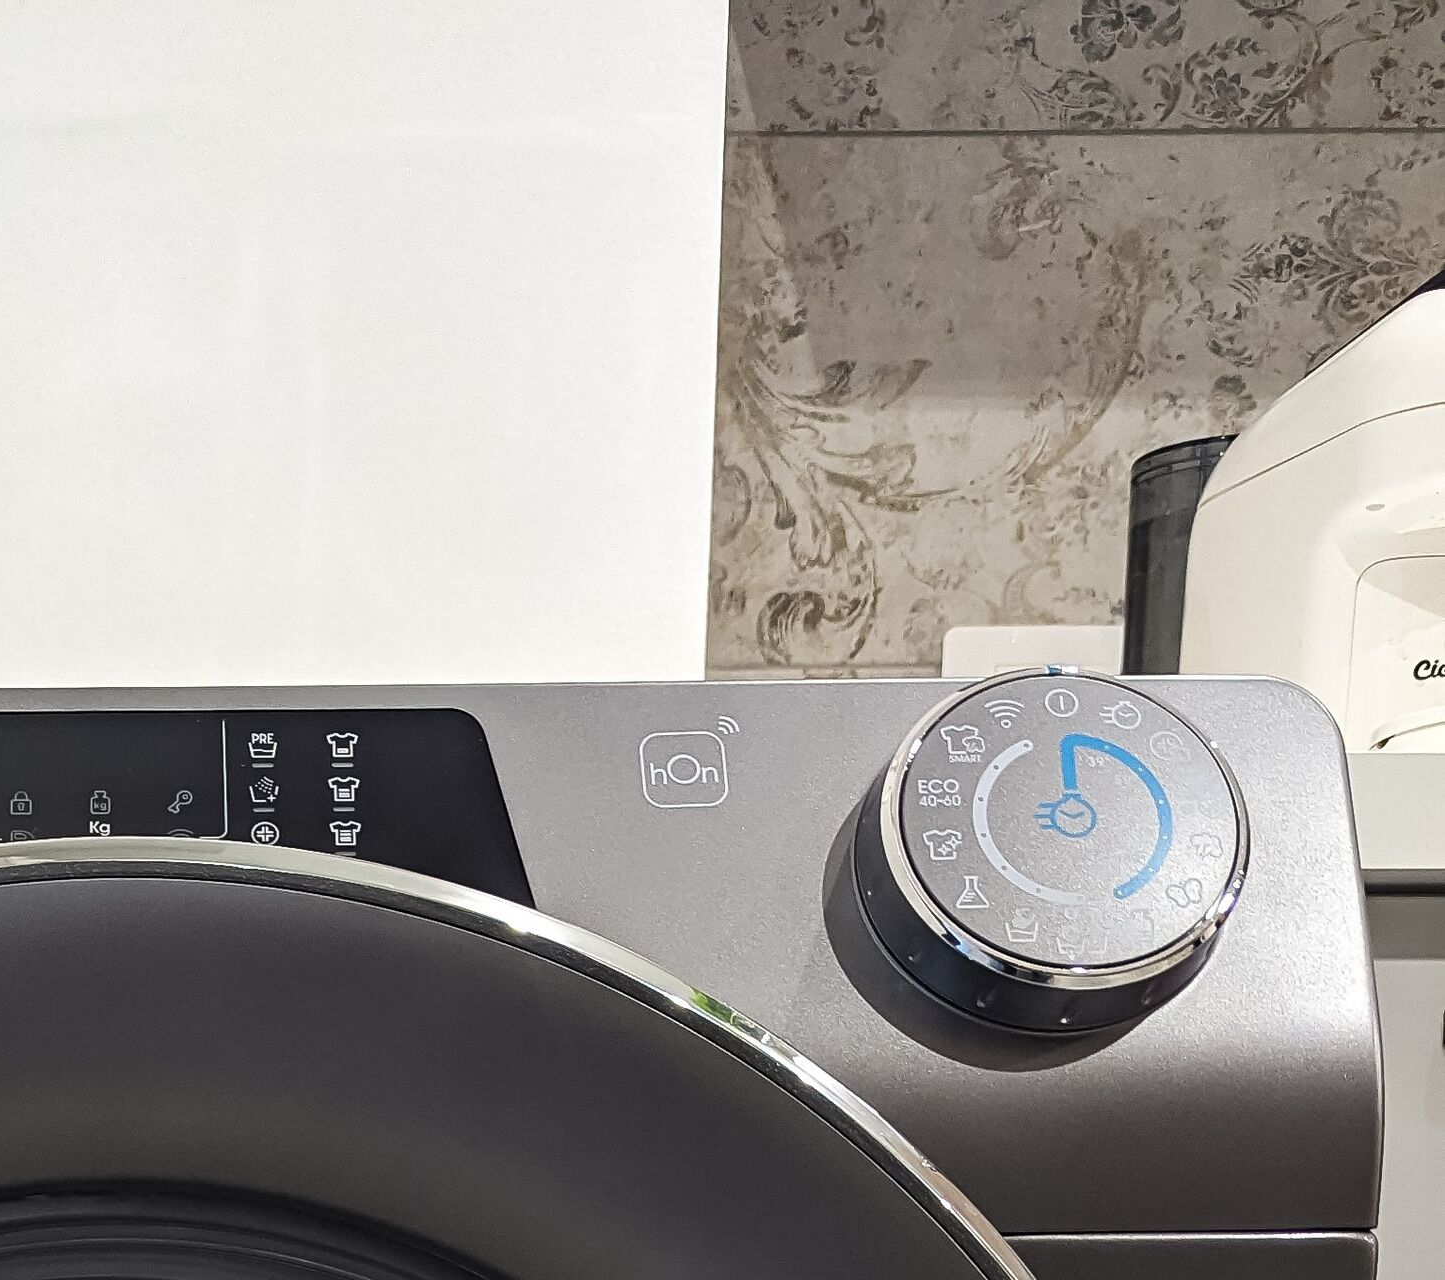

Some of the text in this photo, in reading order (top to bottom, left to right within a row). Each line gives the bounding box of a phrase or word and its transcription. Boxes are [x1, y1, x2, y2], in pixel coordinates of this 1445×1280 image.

[251, 732, 275, 745] PRE
[949, 753, 983, 763] SMART
[649, 753, 720, 786] hOn
[917, 778, 960, 794] ECO
[919, 794, 962, 807] 40-60
[89, 821, 111, 837] Kg
